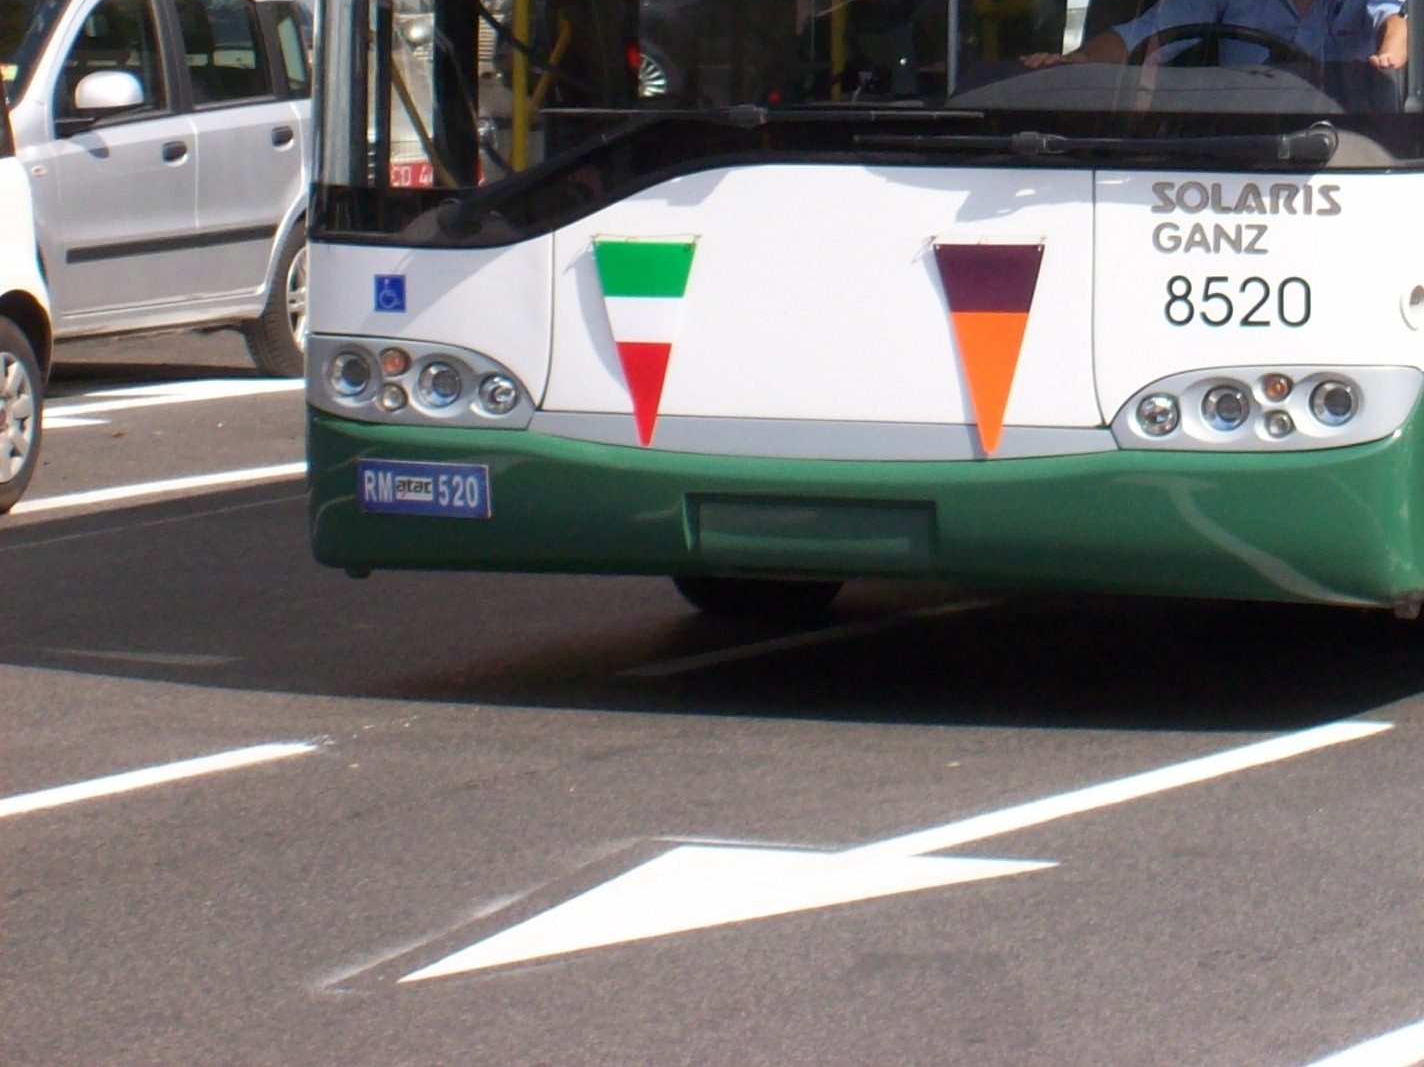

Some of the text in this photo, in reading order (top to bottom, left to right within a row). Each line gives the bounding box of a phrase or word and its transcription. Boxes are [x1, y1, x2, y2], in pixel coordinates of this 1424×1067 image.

[1150, 180, 1342, 216] SOLARIS
[1151, 221, 1269, 254] GANZ
[1163, 274, 1312, 329] 8520
[364, 469, 393, 503] RM
[438, 474, 479, 509] 520
